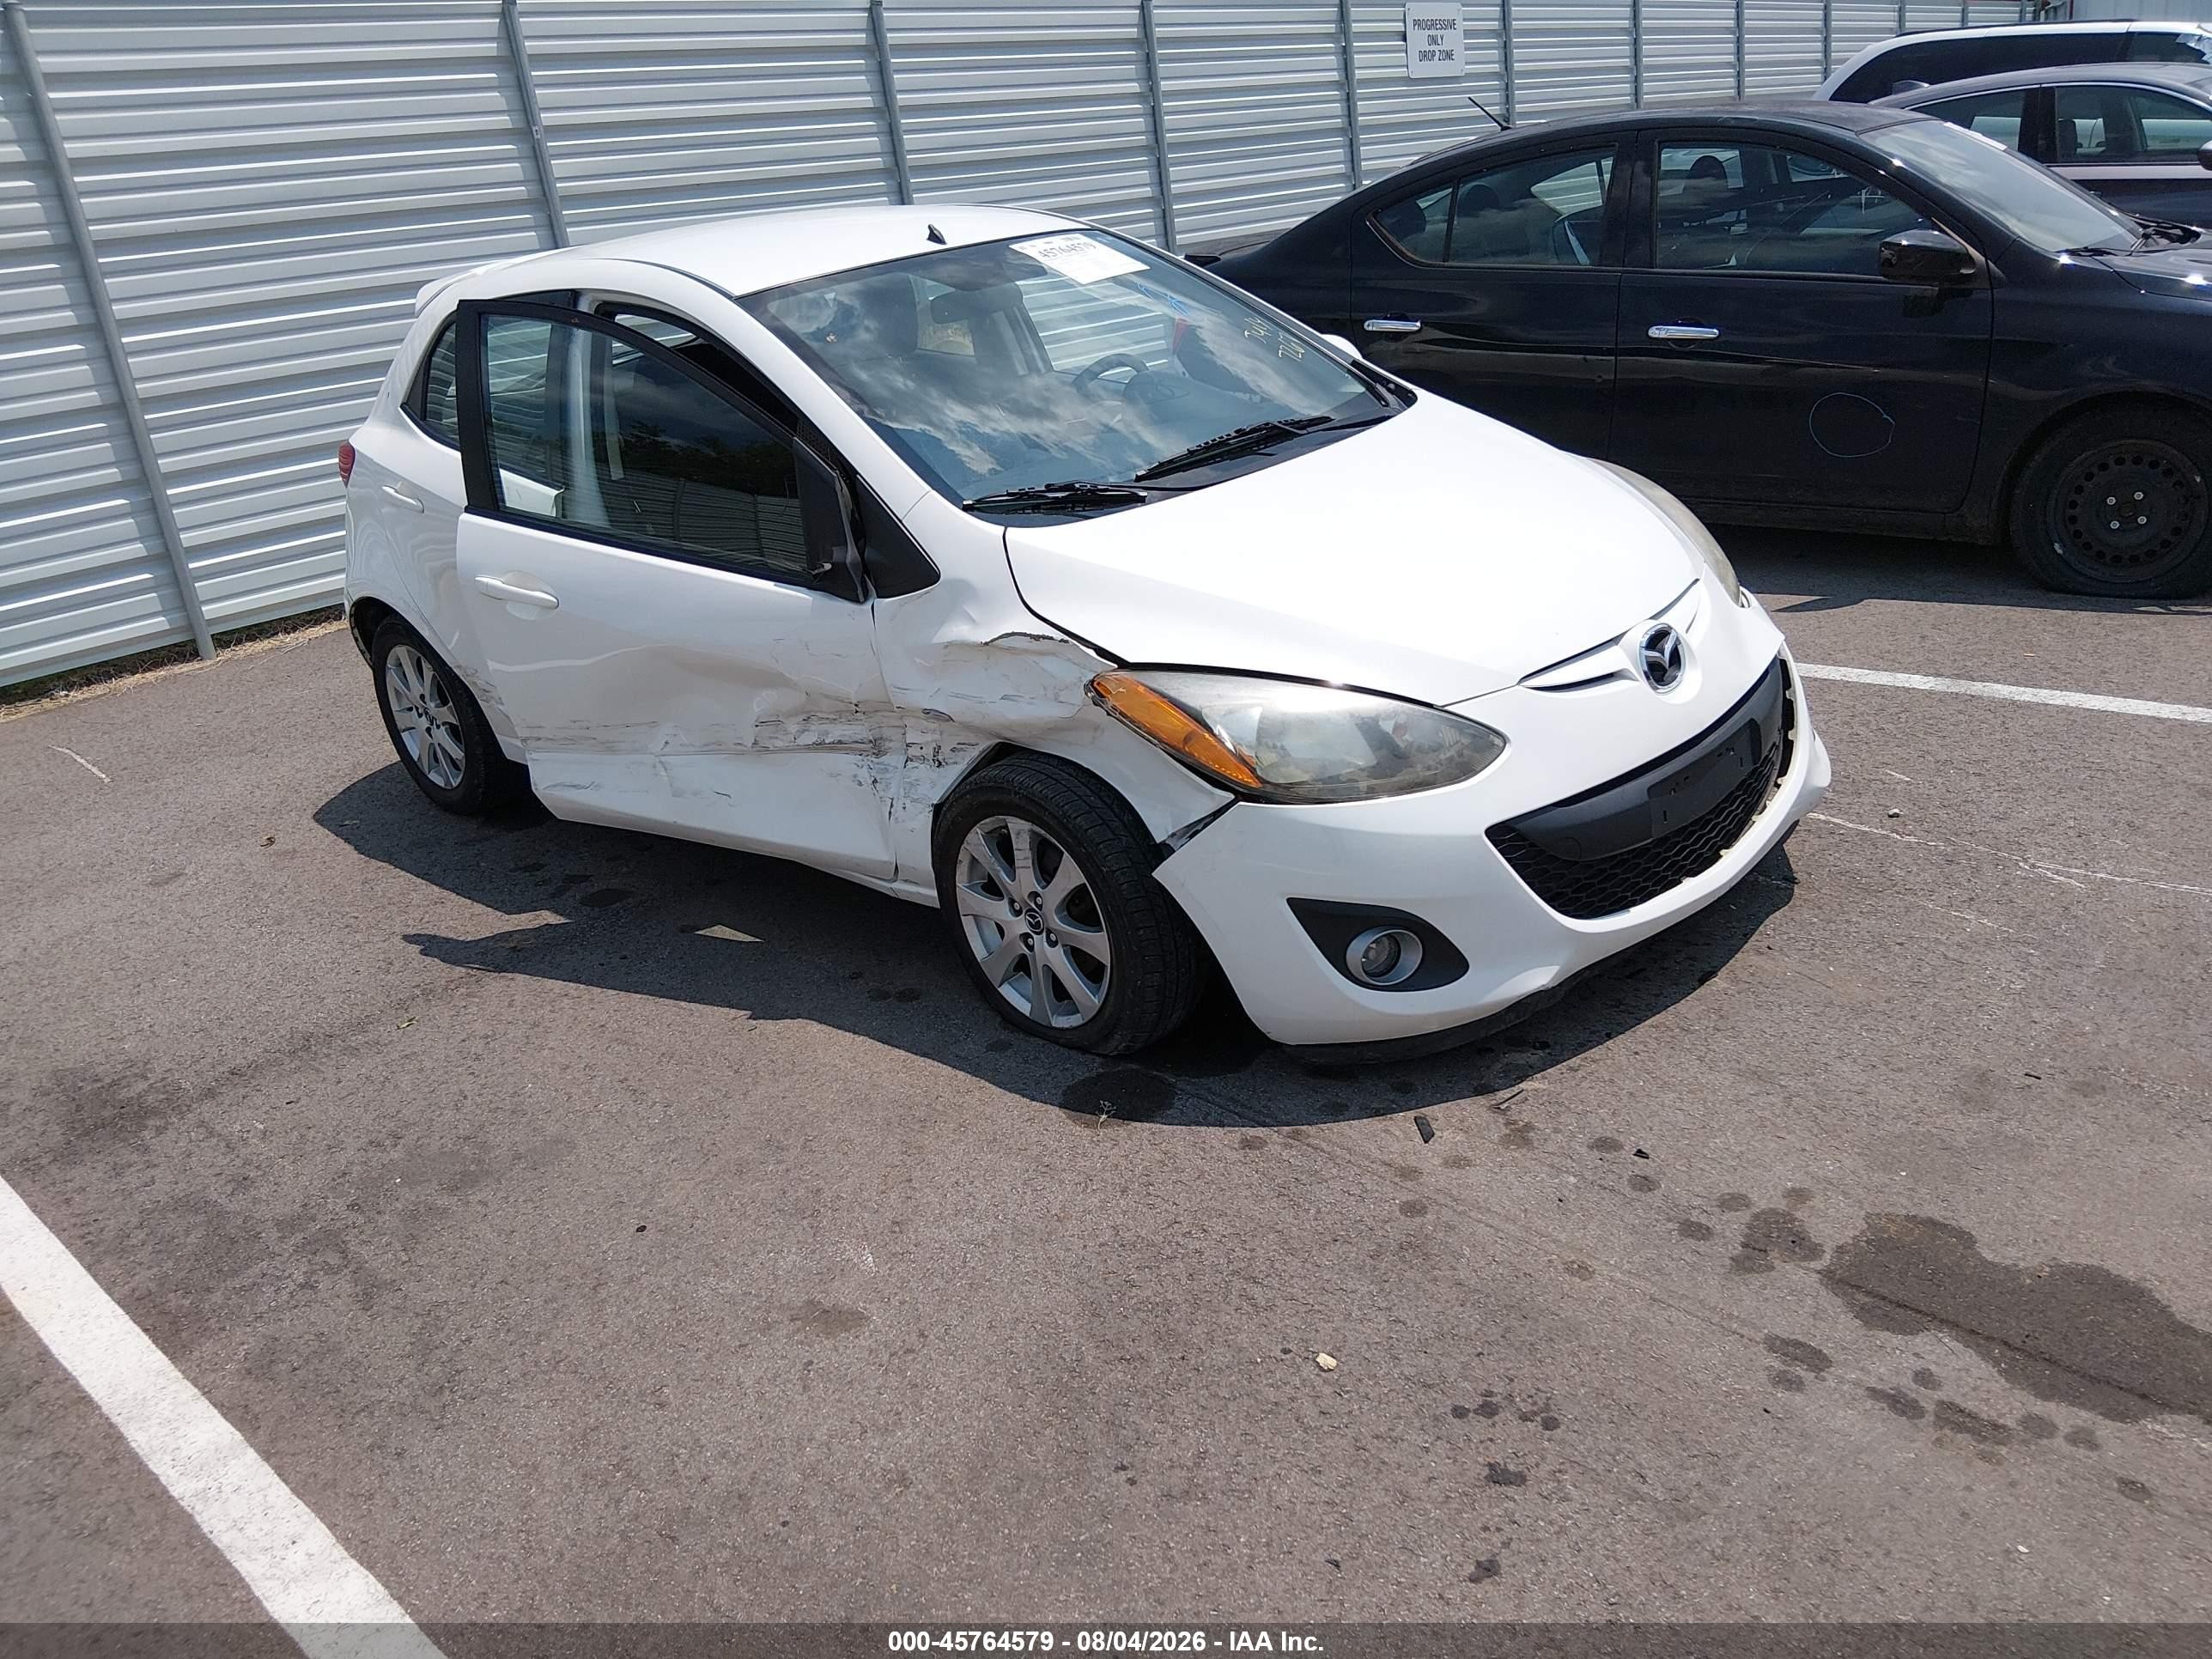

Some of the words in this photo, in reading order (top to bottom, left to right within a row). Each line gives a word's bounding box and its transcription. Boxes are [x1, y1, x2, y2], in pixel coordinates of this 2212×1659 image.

[1413, 18, 1457, 31] PROGRESSIVE
[1427, 34, 1444, 46] ONLY
[1419, 50, 1437, 62] DROP
[1438, 49, 1455, 61] ZONE
[1037, 242, 1097, 258] 45764579
